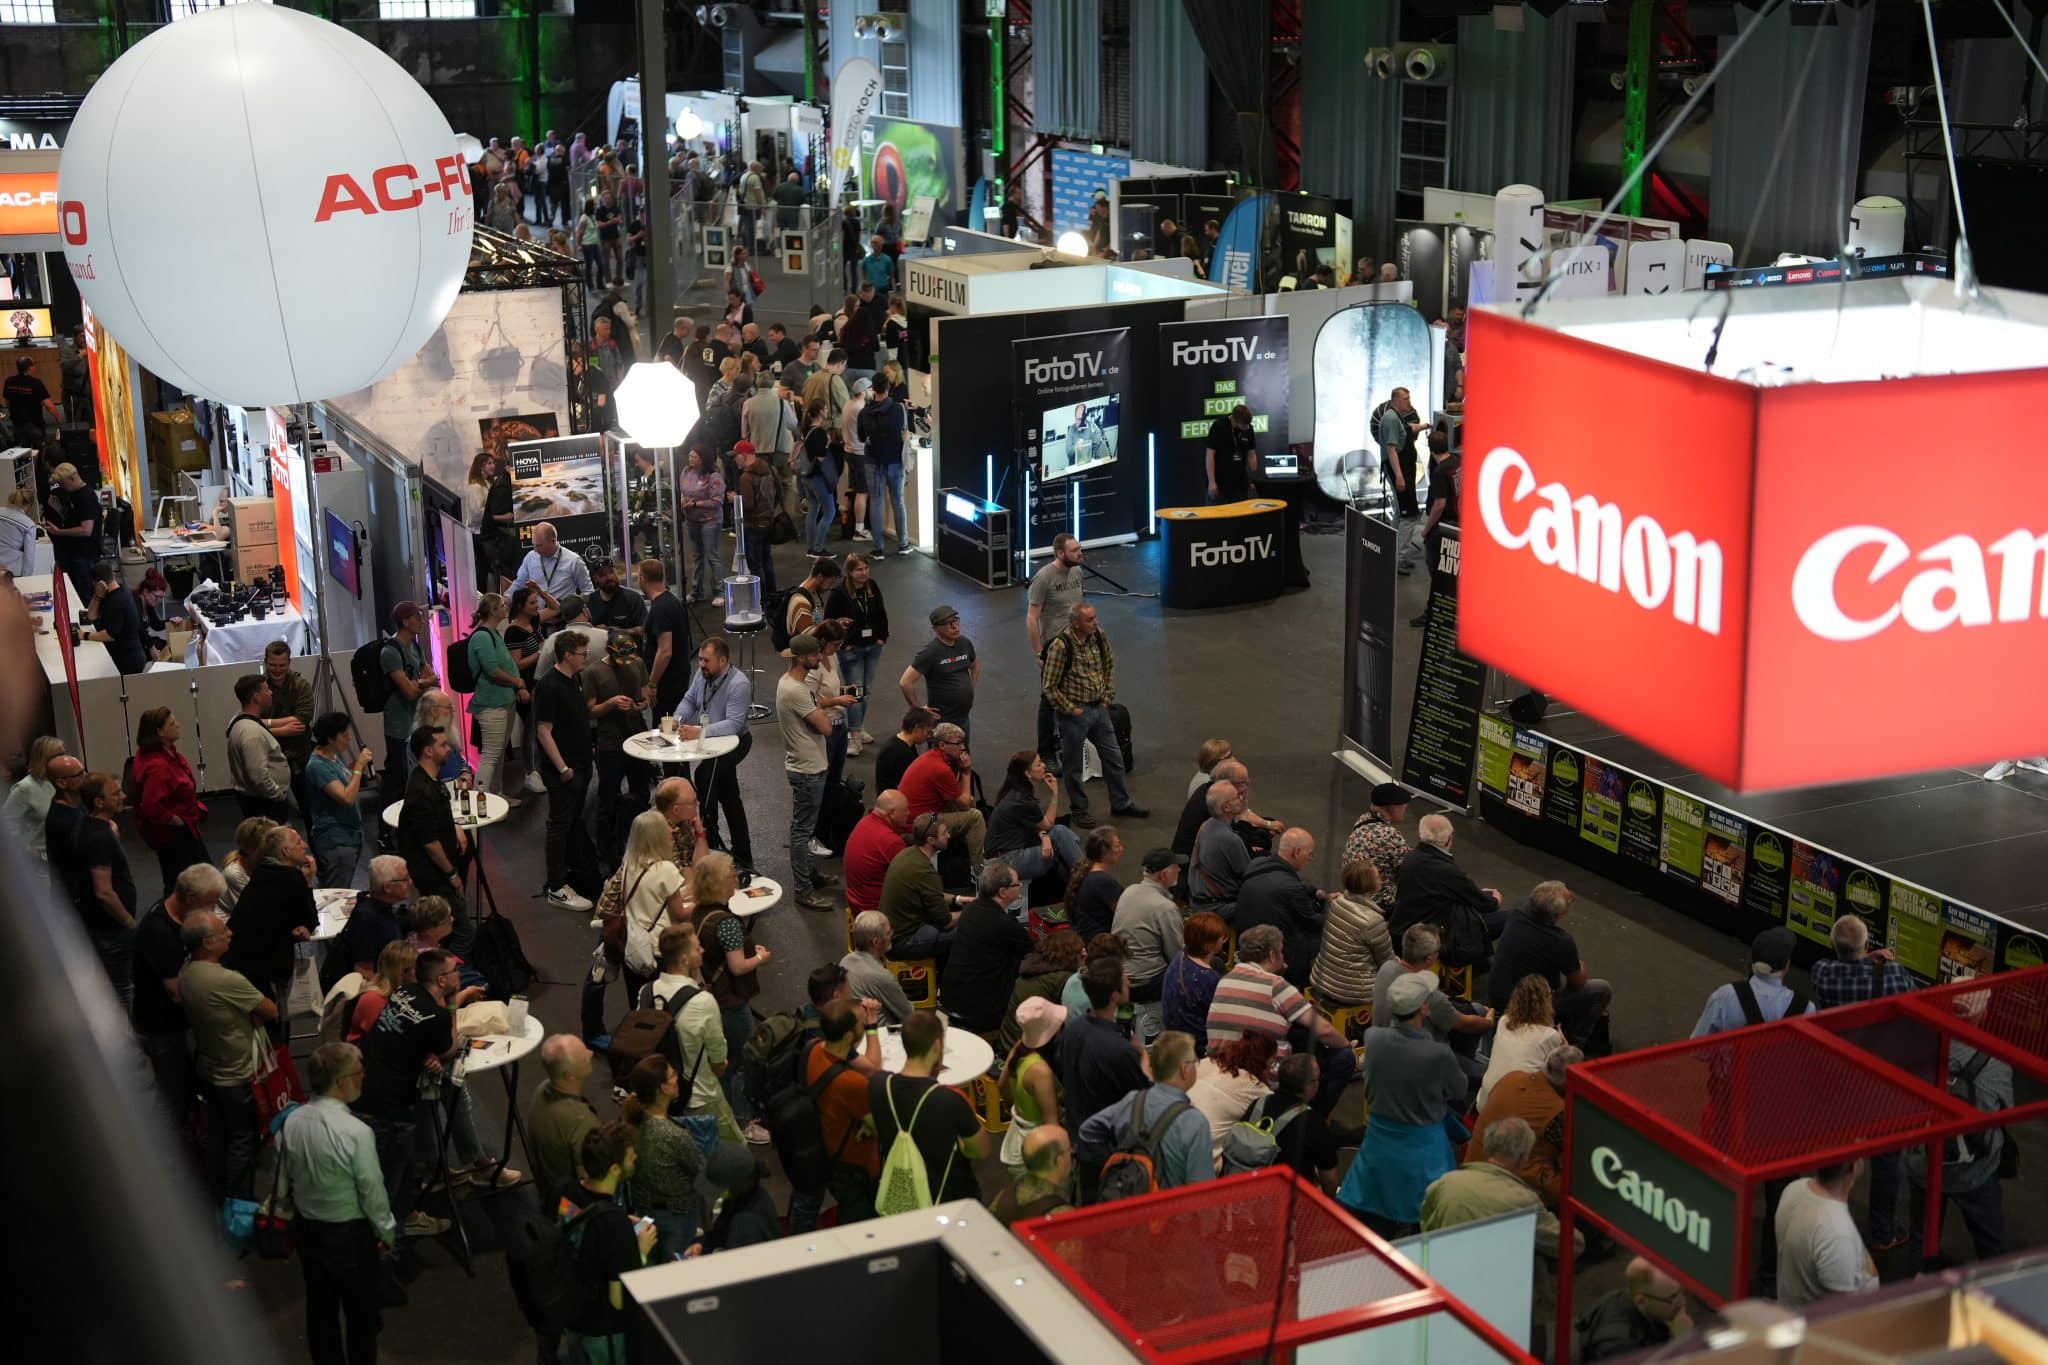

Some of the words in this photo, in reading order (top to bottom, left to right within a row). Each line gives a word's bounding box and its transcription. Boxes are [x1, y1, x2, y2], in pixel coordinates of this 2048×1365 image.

[1287, 211, 1327, 229] TAMRON
[1788, 271, 1812, 280] Lenovo
[910, 271, 966, 306] FUJIFILM
[1216, 383, 1234, 391] DAS
[516, 457, 538, 466] HOYA
[1362, 537, 1380, 554] TAMRON
[1478, 446, 1723, 636] Canon
[1805, 881, 1835, 899] SPECIALS
[1892, 884, 1918, 904] PHOTO
[1891, 896, 1939, 925] ADVENTURE
[1591, 1146, 1711, 1253] Canon
